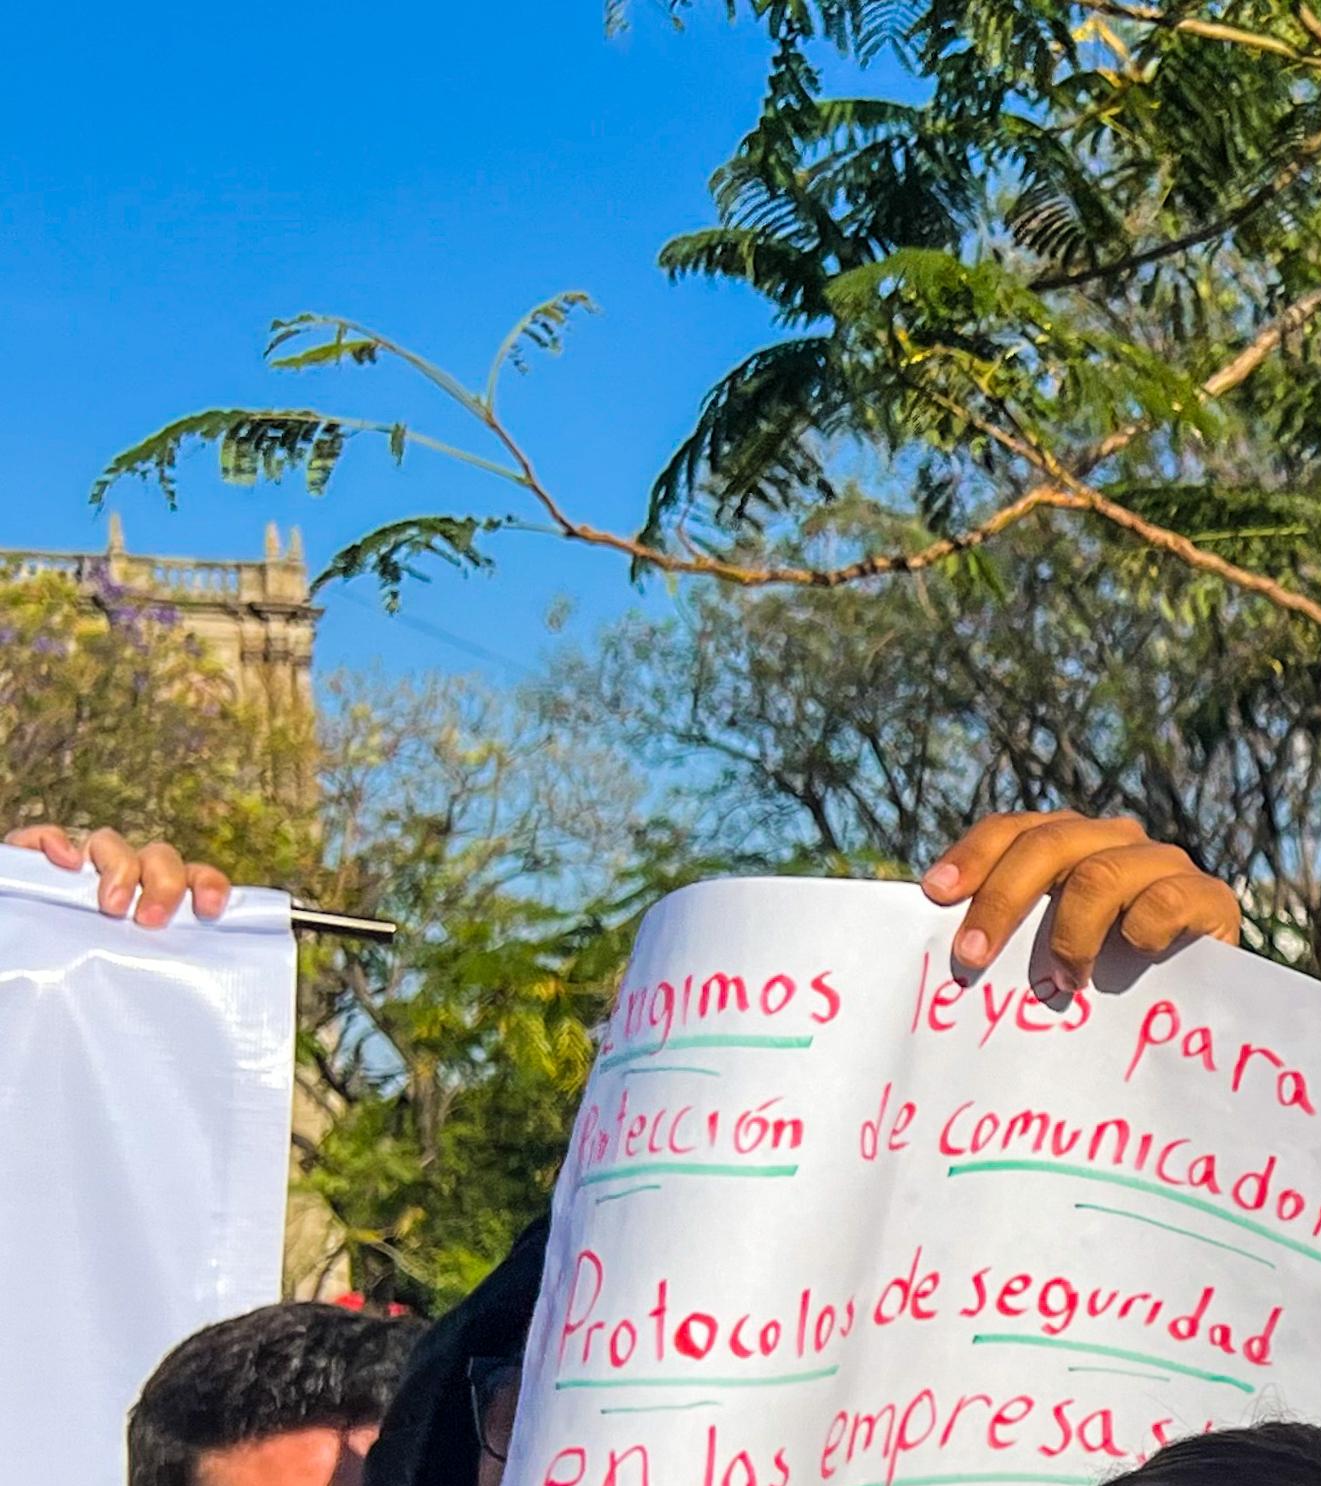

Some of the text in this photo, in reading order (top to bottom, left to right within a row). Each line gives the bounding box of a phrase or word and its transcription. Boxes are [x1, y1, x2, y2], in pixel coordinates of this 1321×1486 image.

[911, 951, 1092, 1049] leyes
[1124, 999, 1317, 1116] para
[859, 1082, 917, 1162] de
[555, 1245, 1284, 1371] Protocolos de seguridad
